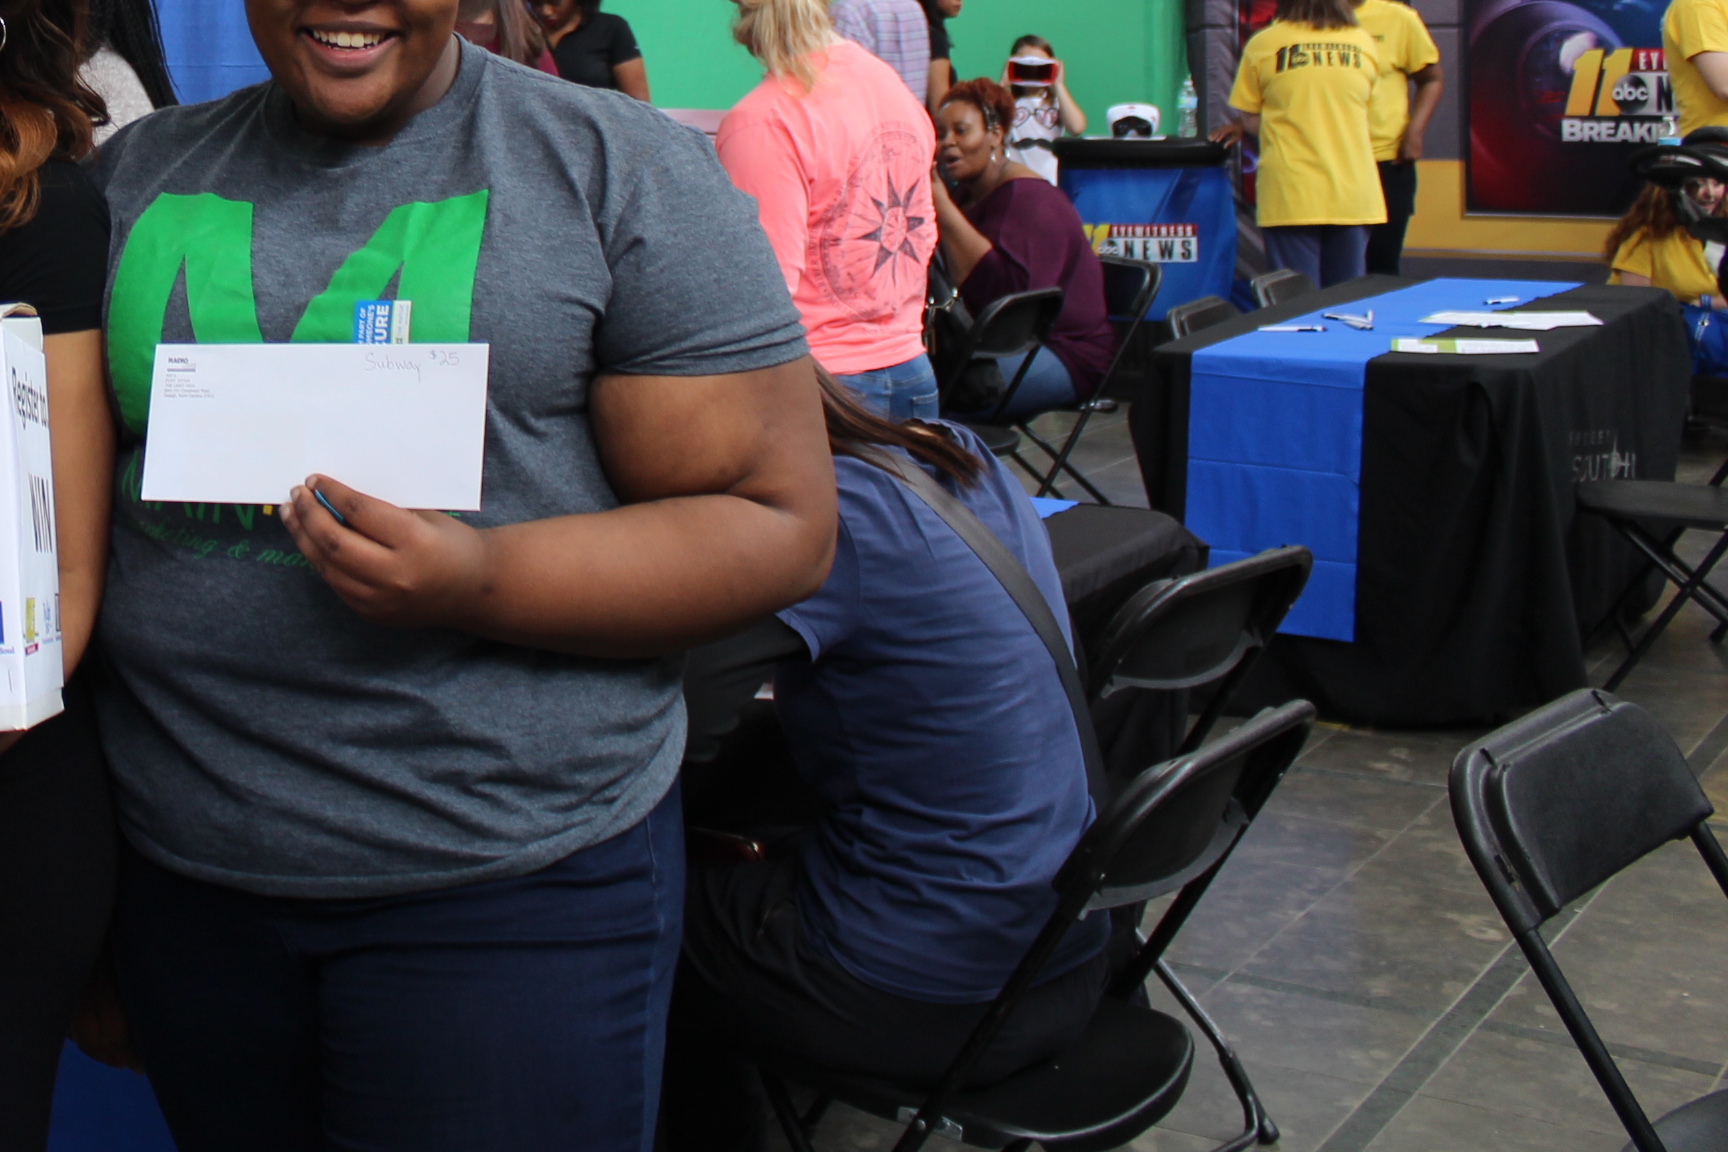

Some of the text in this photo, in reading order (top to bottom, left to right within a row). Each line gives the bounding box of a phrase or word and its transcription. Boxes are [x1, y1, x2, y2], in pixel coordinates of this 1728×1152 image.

[1564, 48, 1633, 117] 11
[1612, 83, 1649, 101] abc
[1561, 118, 1661, 143] BREAKI
[1123, 239, 1192, 260] NEWS
[374, 304, 390, 345] URE
[364, 352, 422, 383] Subway
